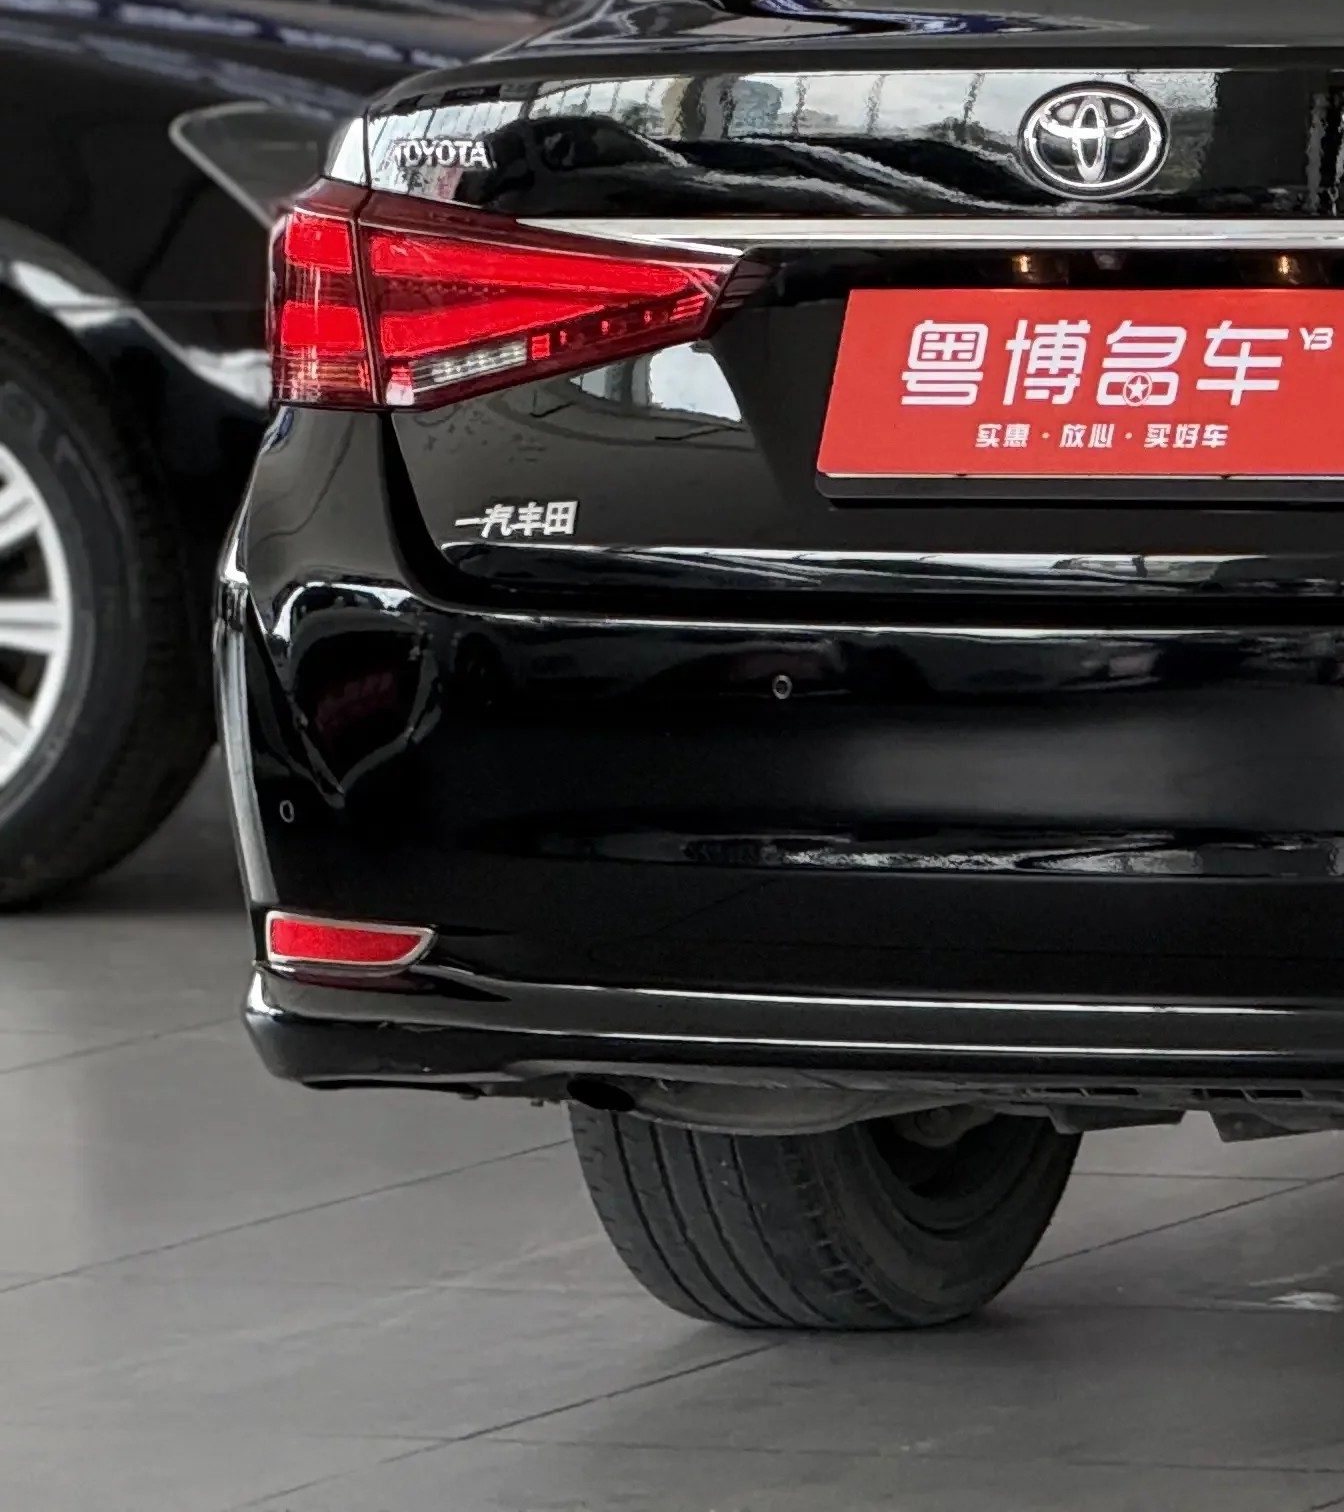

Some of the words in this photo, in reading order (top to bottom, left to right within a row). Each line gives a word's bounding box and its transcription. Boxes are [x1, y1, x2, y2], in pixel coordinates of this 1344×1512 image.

[393, 139, 491, 169] TOYOTA
[901, 320, 1290, 406] 粤博名车
[454, 501, 578, 538] 一汽丰田
